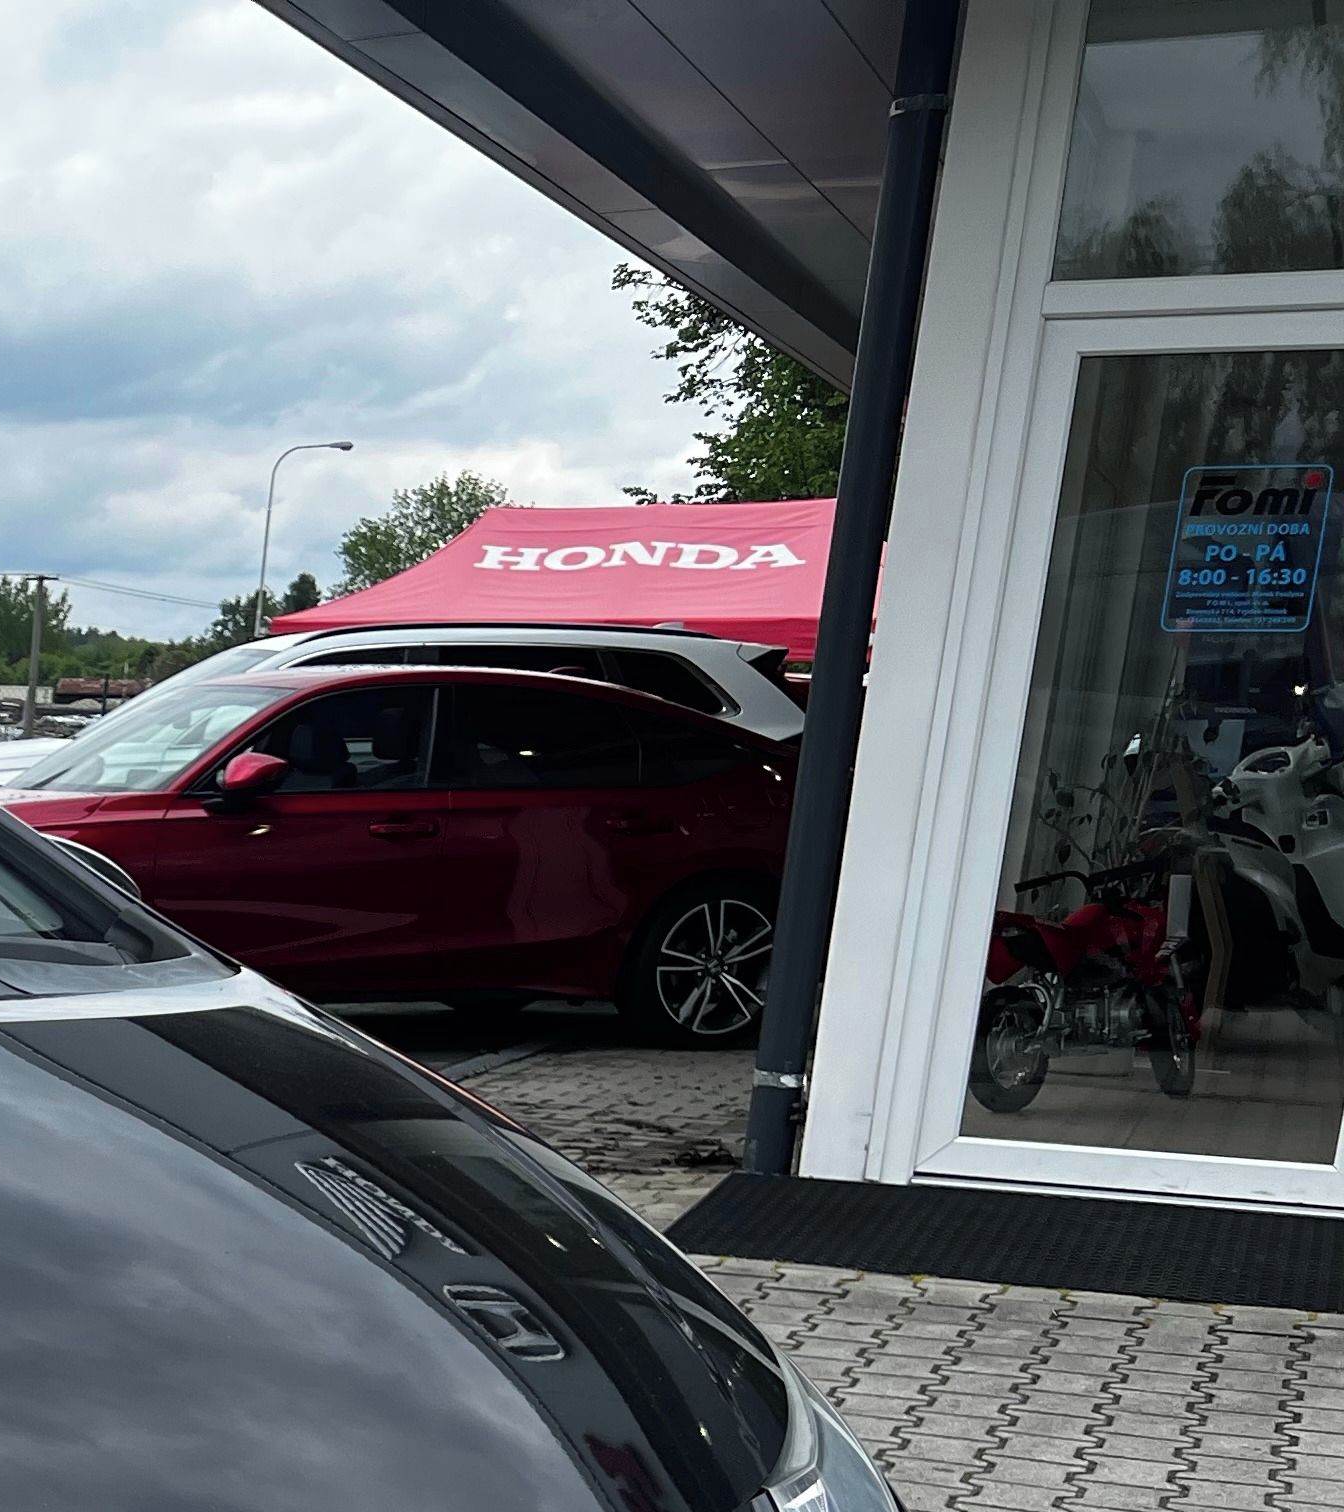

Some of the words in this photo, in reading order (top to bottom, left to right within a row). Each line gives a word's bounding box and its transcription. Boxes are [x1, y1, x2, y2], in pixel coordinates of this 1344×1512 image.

[1186, 521, 1264, 536] PROVOZNÍ
[1267, 522, 1310, 535] DOBA
[473, 540, 806, 572] HONDA
[1205, 544, 1237, 562] PO
[1255, 540, 1285, 562] PÁ
[1178, 569, 1227, 586] 8:00
[1246, 568, 1307, 586] 16:30
